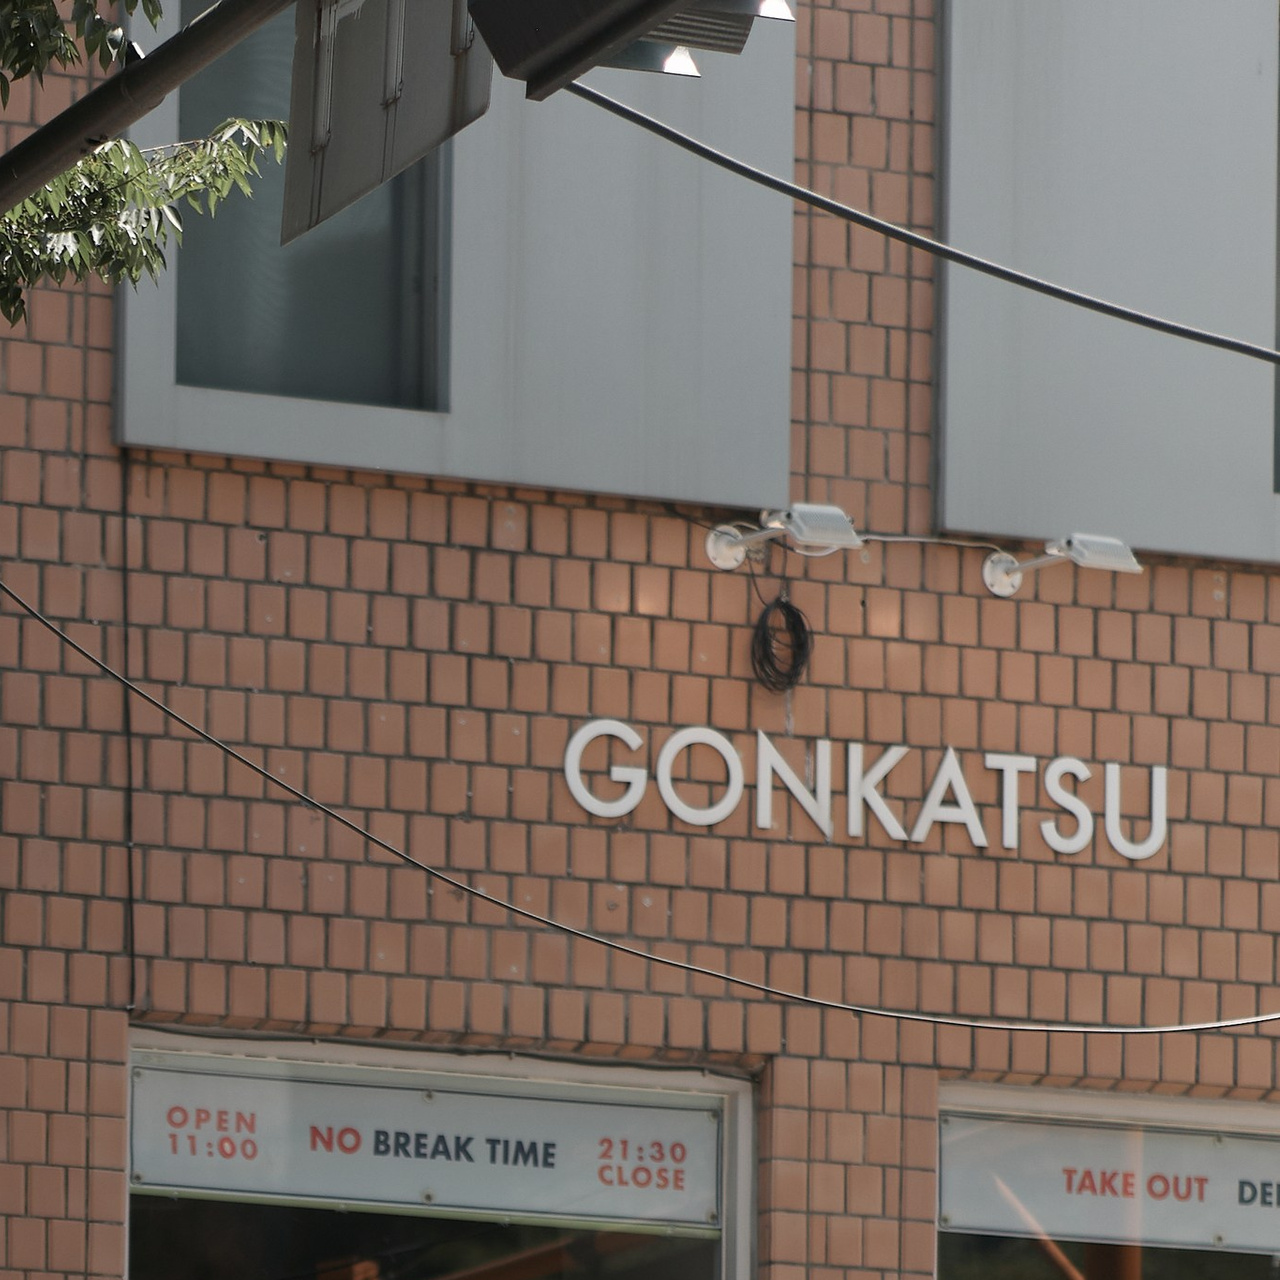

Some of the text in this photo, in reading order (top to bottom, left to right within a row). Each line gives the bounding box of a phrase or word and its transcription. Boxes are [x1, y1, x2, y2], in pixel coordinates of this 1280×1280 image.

[564, 718, 1169, 862] GONKATSU
[166, 1105, 257, 1134] OPEN
[167, 1133, 258, 1161] 11:00
[309, 1125, 556, 1169] NO BREAK TIME
[598, 1138, 687, 1164] 21:30
[597, 1165, 686, 1192] CLOSE
[1062, 1167, 1209, 1202] TAKE OUT
